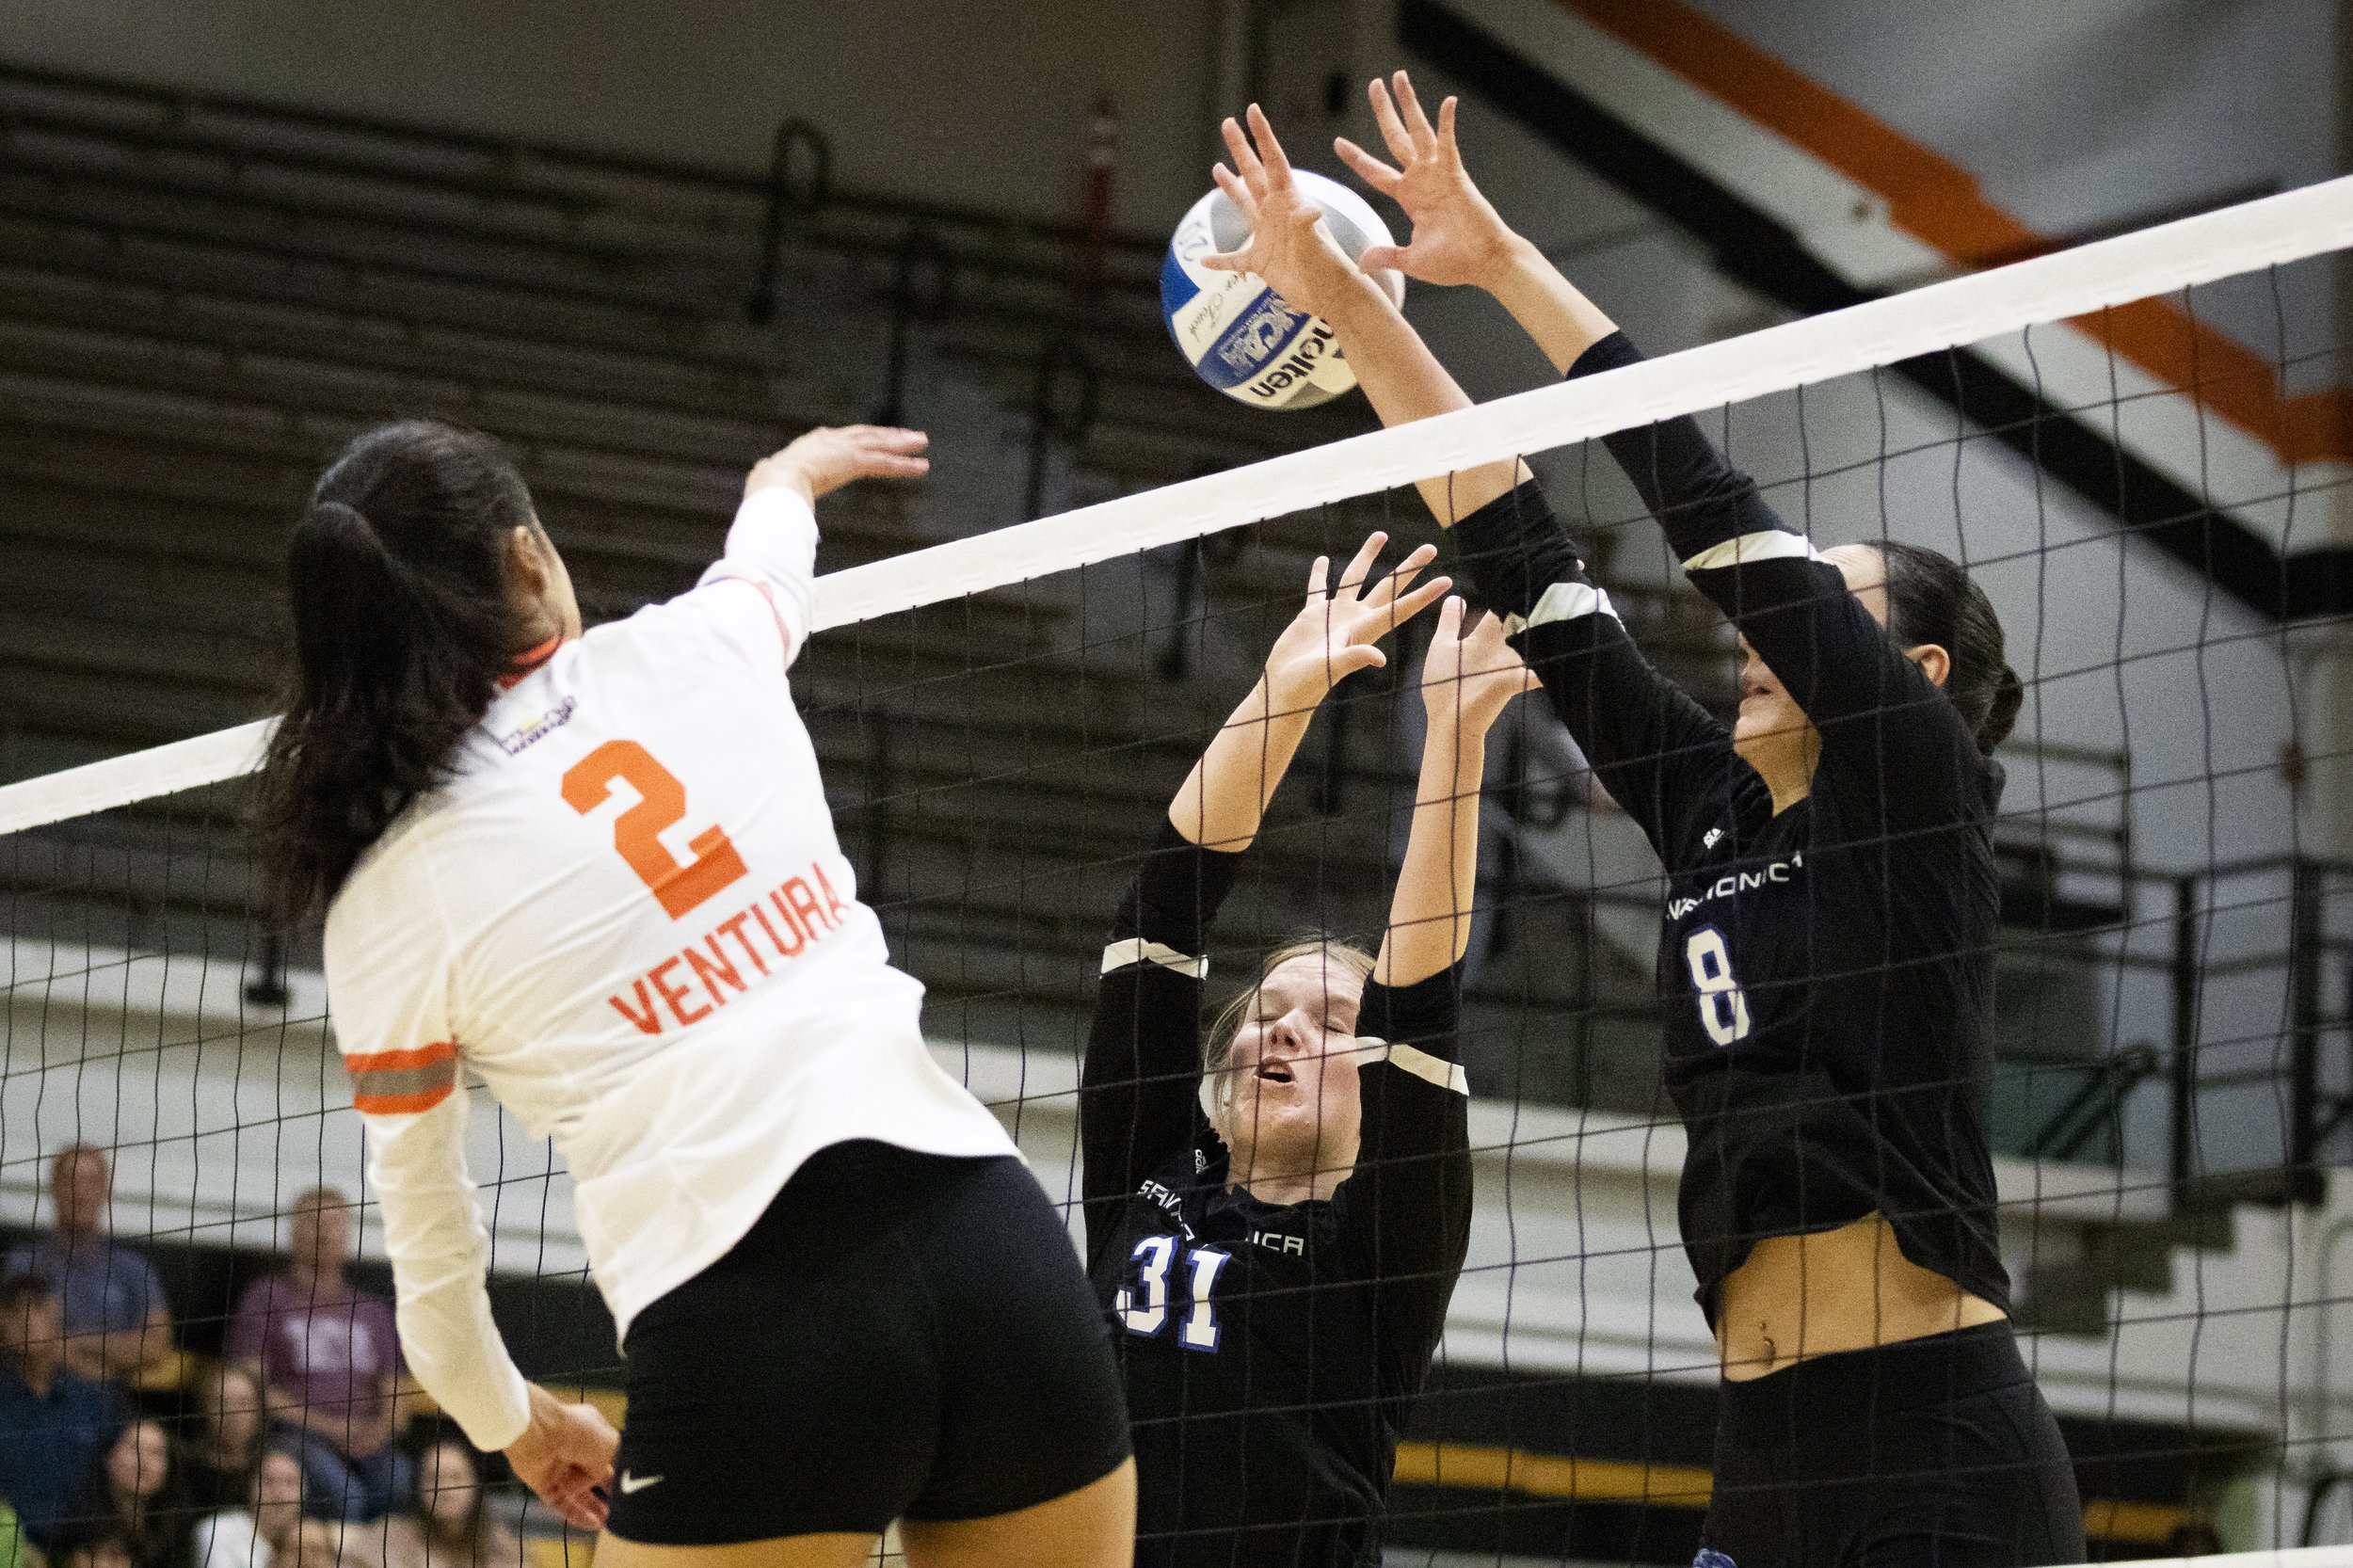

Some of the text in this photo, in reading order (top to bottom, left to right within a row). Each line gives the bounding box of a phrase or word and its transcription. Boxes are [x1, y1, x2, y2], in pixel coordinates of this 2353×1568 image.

[1218, 298, 1295, 373] NCAA
[561, 740, 750, 921] 2
[608, 860, 850, 1034] VENTURA
[1685, 926, 1753, 1047] 8
[1114, 1235, 1232, 1352] 31
